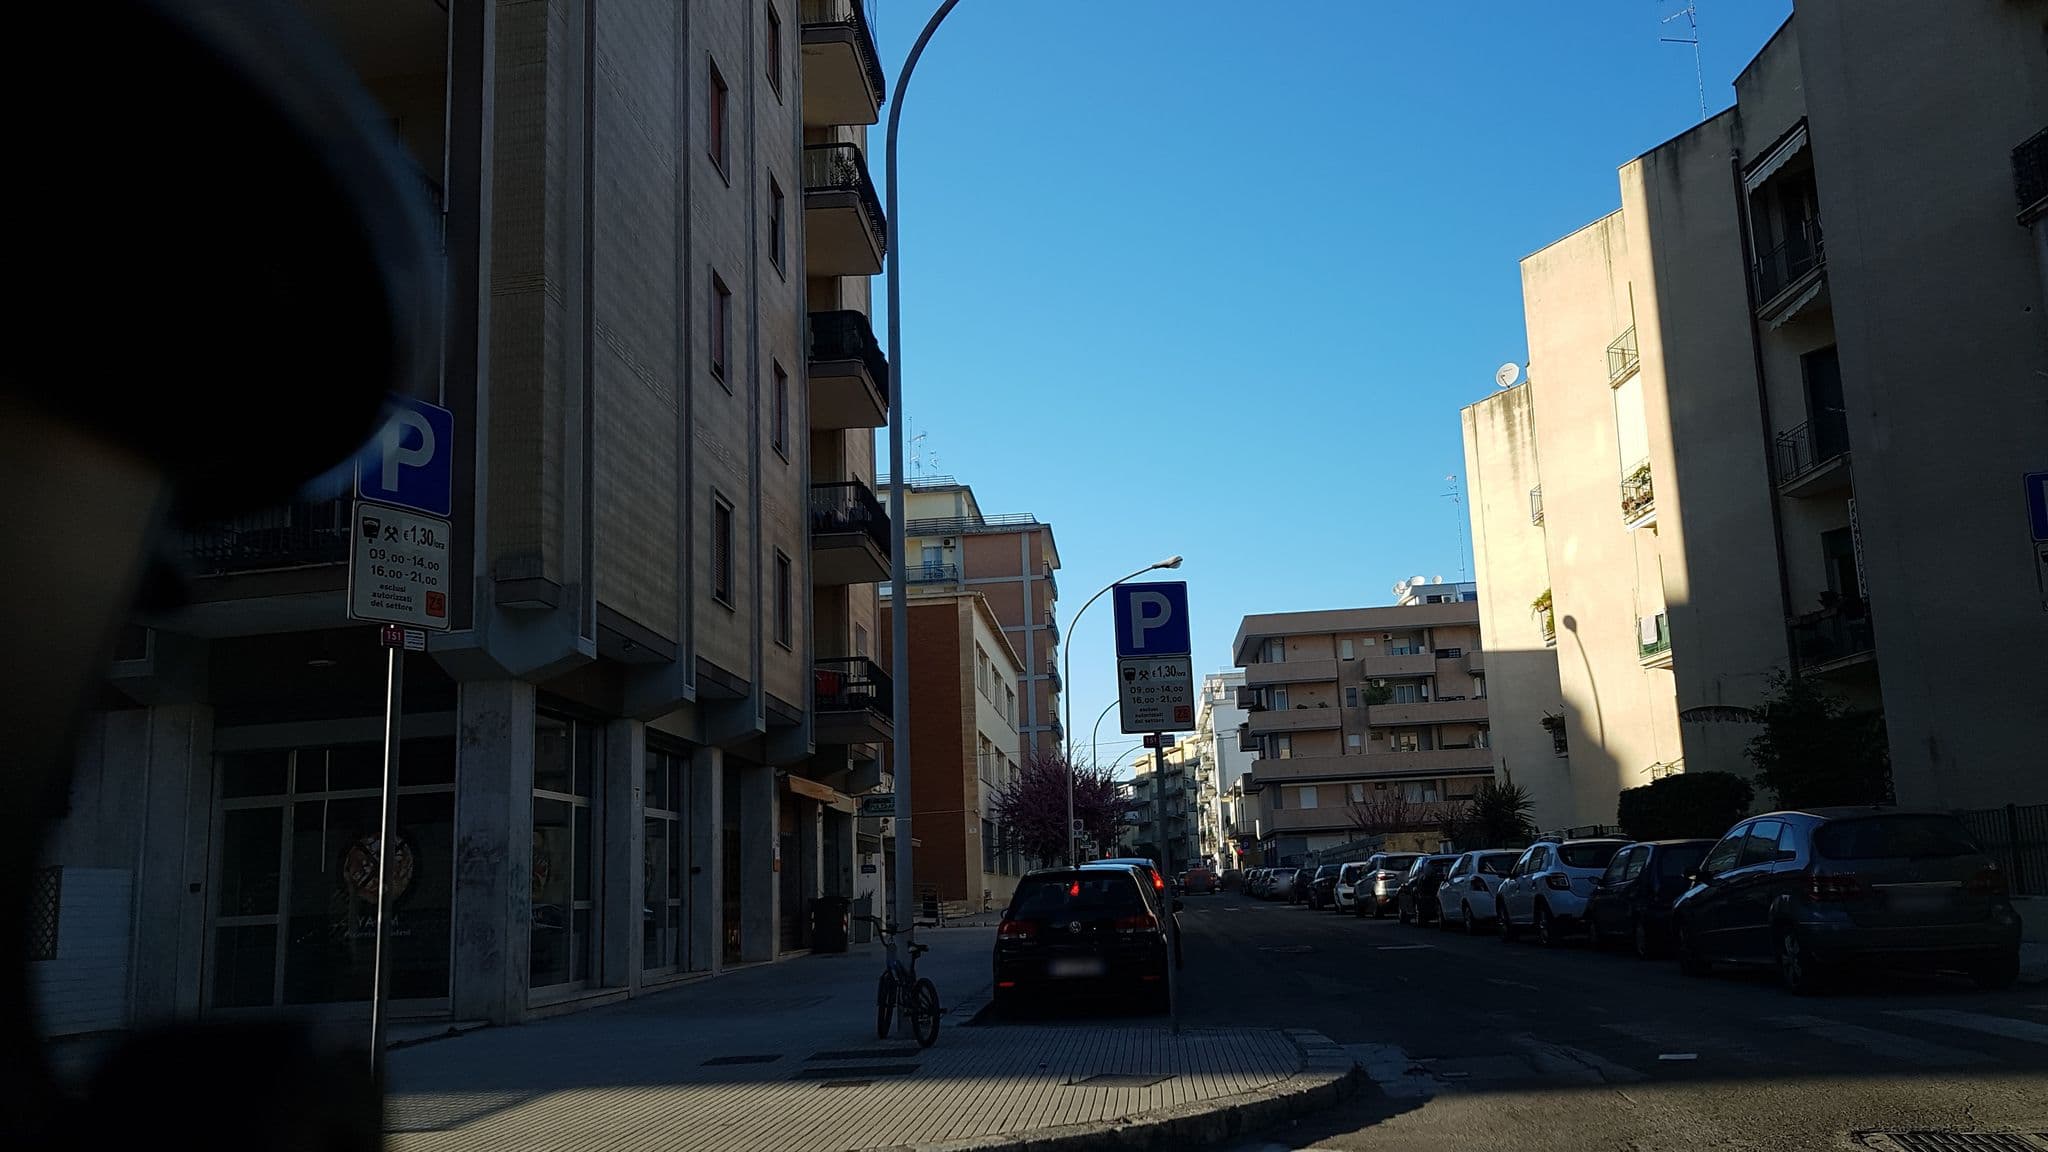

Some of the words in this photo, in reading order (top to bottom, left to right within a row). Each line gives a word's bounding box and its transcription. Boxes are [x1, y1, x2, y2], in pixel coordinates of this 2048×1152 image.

[381, 409, 435, 492] P
[379, 584, 406, 592] esclusi
[371, 591, 412, 602] autorizzati
[370, 600, 383, 608] del
[385, 602, 413, 611] settore
[1130, 591, 1172, 649] P
[386, 630, 401, 641] 151
